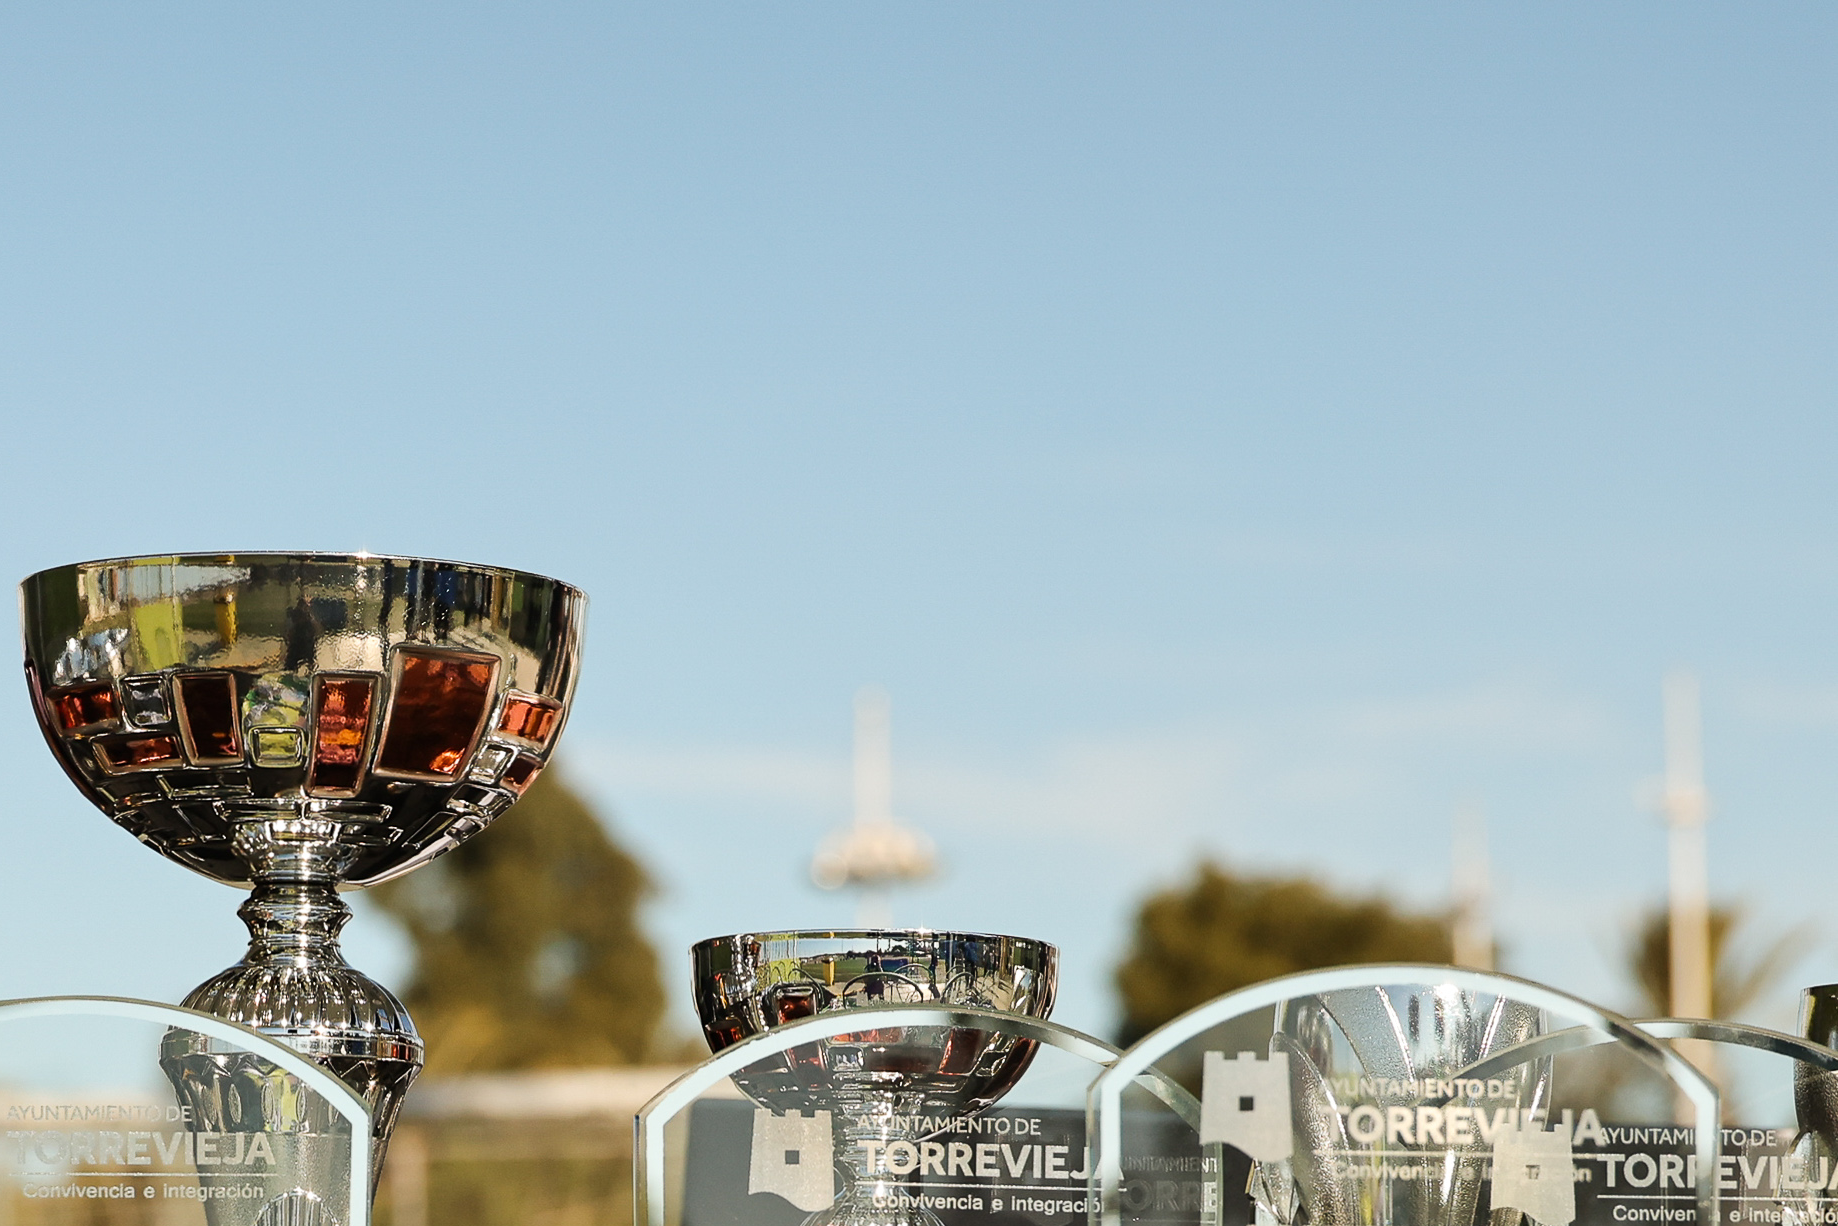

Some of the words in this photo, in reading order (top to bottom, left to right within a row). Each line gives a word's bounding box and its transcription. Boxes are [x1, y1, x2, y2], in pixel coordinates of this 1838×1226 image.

[1325, 1077, 1485, 1100] AYUNTAMIENTO
[1487, 1079, 1517, 1100] DE
[6, 1105, 160, 1123] AYUNTAMIENTO
[166, 1105, 192, 1123] DE
[857, 1114, 1010, 1135] AYUNTAMIENTO
[1014, 1117, 1042, 1136] DE
[1601, 1127, 1747, 1146] AYUNTAMITO
[1750, 1130, 1777, 1146] DE
[6, 1130, 276, 1166] TORREVIEJA
[857, 1139, 1124, 1181] TORREVIEJA
[1332, 1162, 1452, 1182] Convivenci
[22, 1183, 135, 1199] Convivencia
[143, 1186, 155, 1199] e
[163, 1182, 264, 1202] integración
[872, 1193, 983, 1210] Convivencia
[991, 1200, 1003, 1211] e
[1012, 1195, 1107, 1214] integració
[1613, 1204, 1720, 1222] Convivena
[1729, 1210, 1741, 1222] e
[1749, 1206, 1838, 1226] inteació
